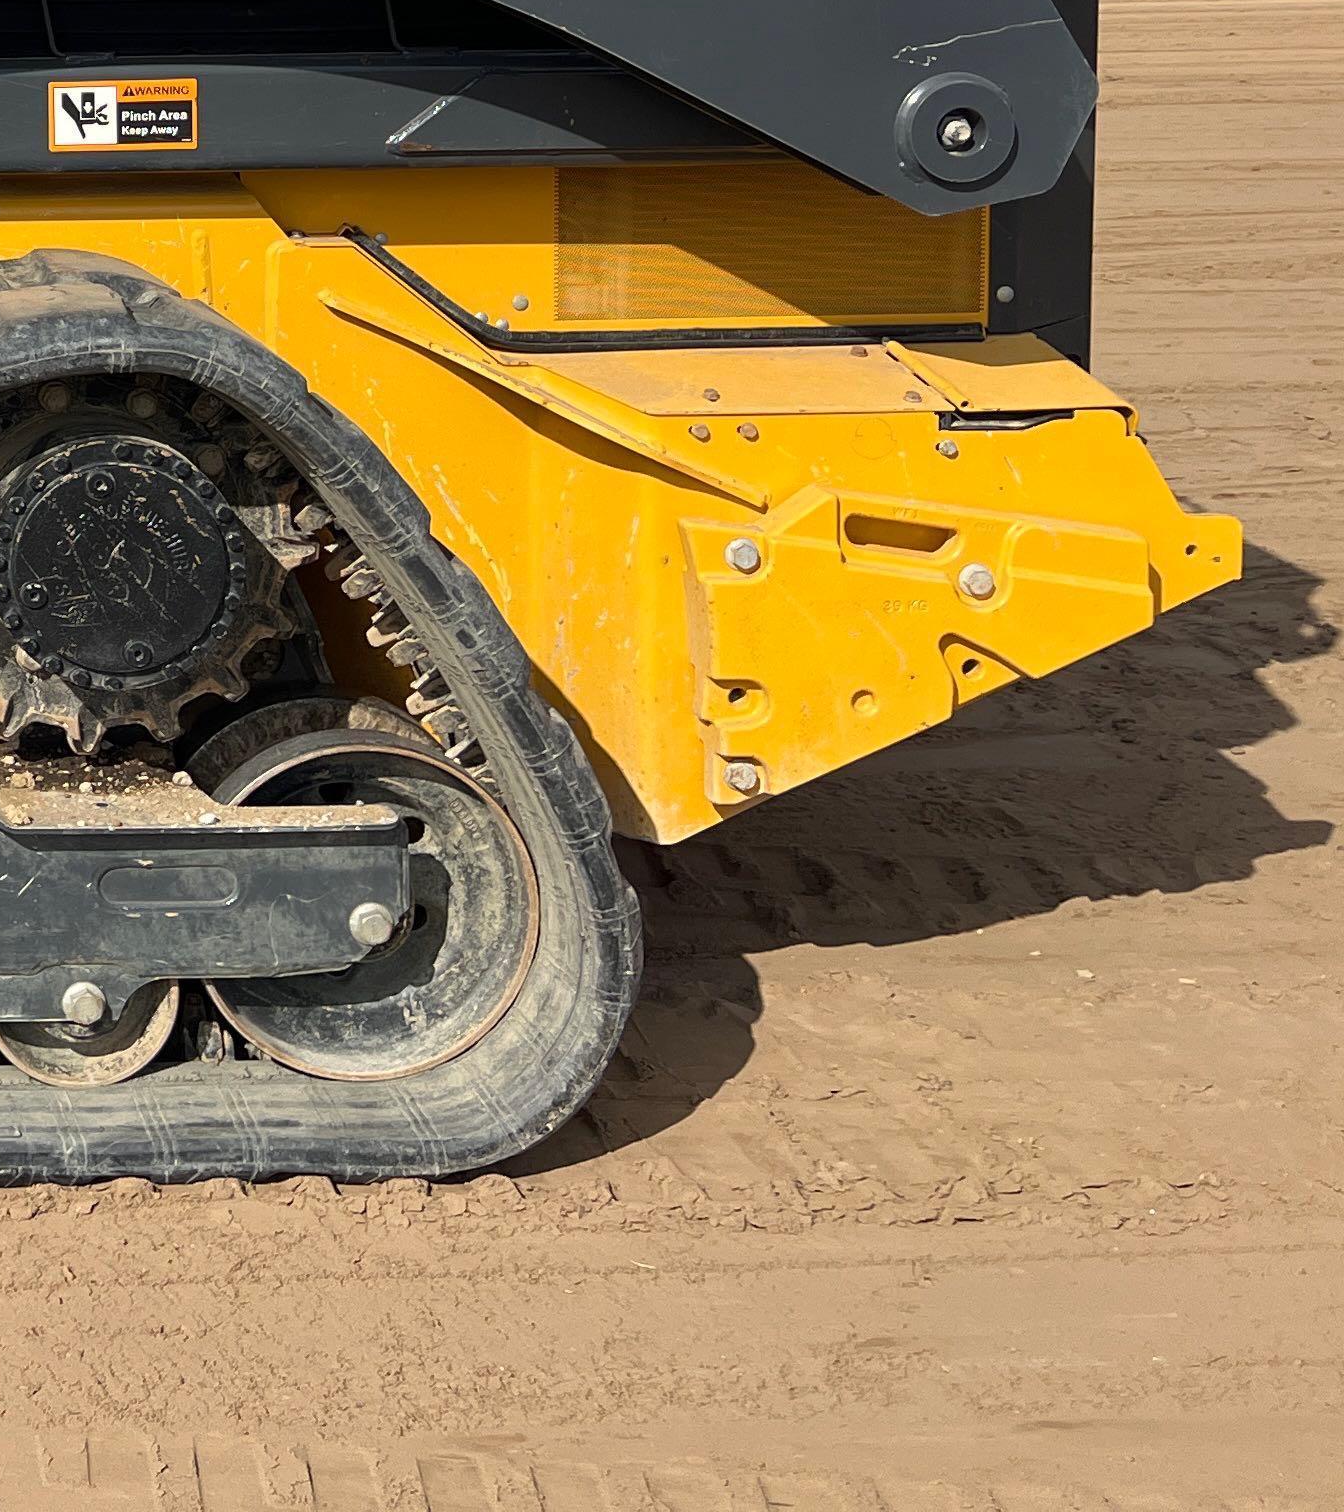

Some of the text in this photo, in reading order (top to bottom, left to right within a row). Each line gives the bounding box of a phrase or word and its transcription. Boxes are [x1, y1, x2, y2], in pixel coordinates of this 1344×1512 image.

[134, 85, 190, 96] WARNING
[121, 109, 188, 122] Pinch Area
[121, 125, 179, 137] Keep Away
